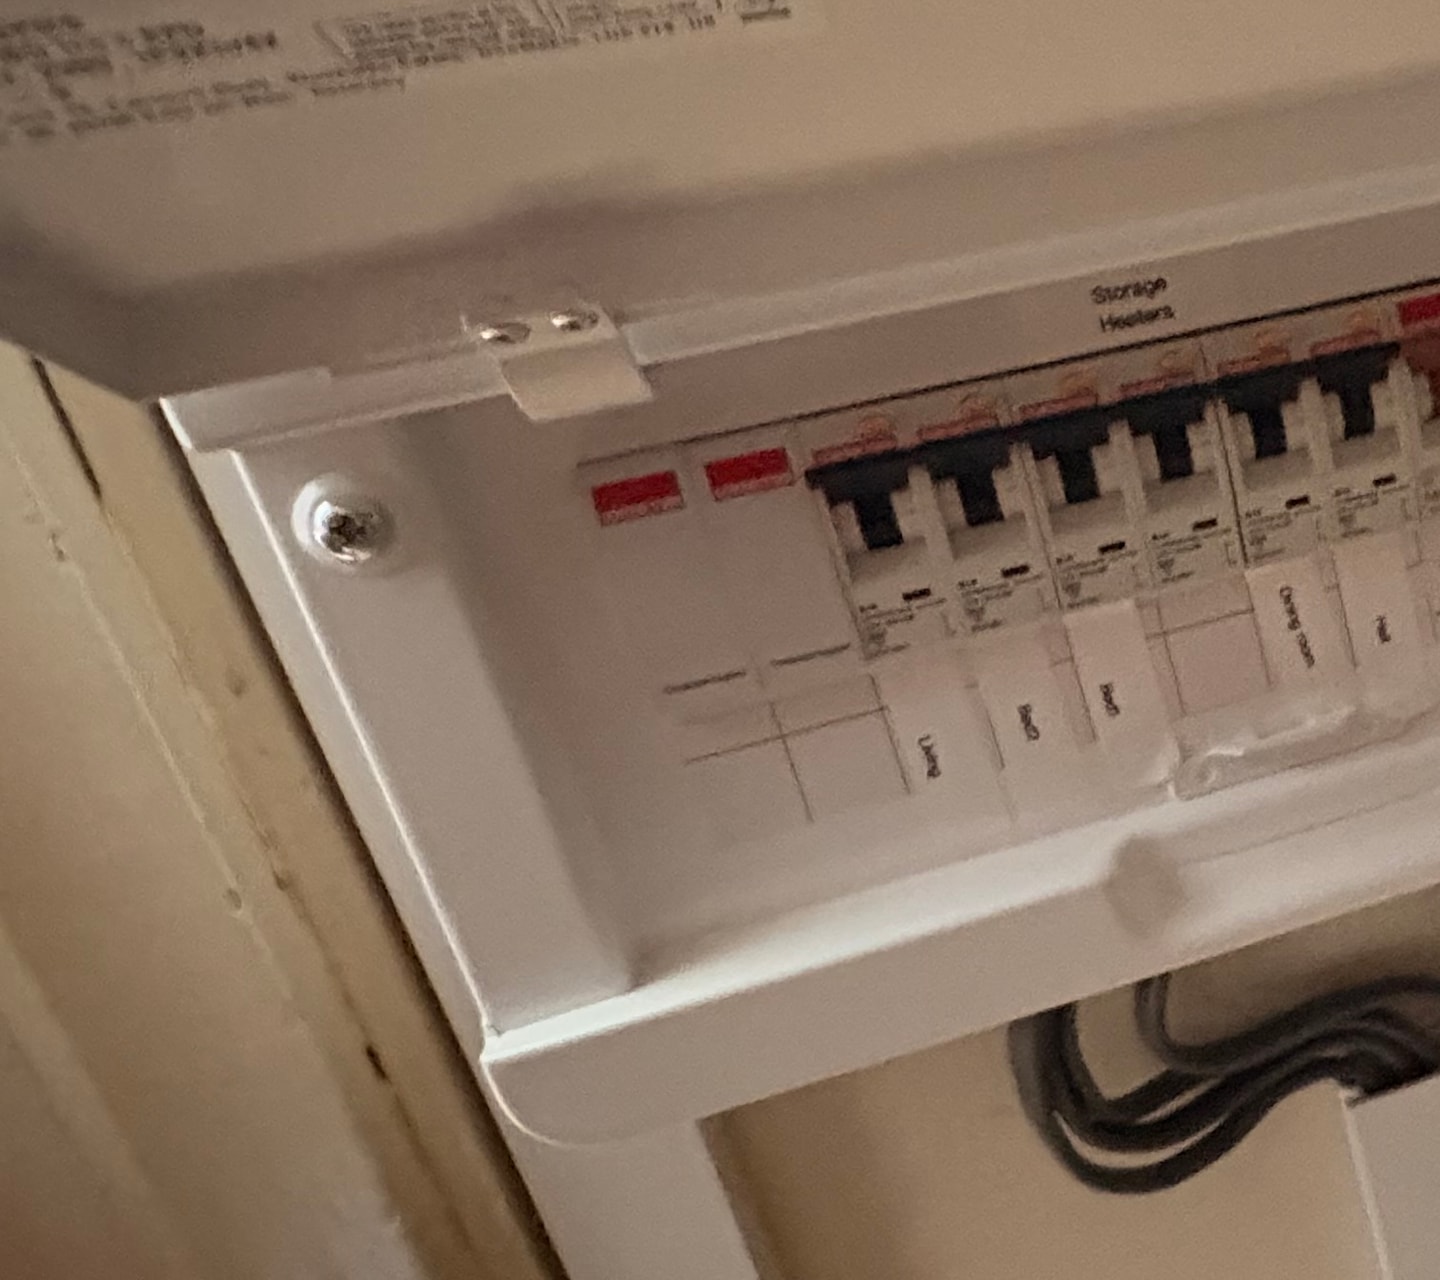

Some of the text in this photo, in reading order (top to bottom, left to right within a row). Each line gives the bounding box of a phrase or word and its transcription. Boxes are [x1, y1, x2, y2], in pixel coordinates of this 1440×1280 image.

[1090, 277, 1167, 303] Storage
[1099, 304, 1175, 332] Heaters
[1279, 585, 1301, 631] Dining
